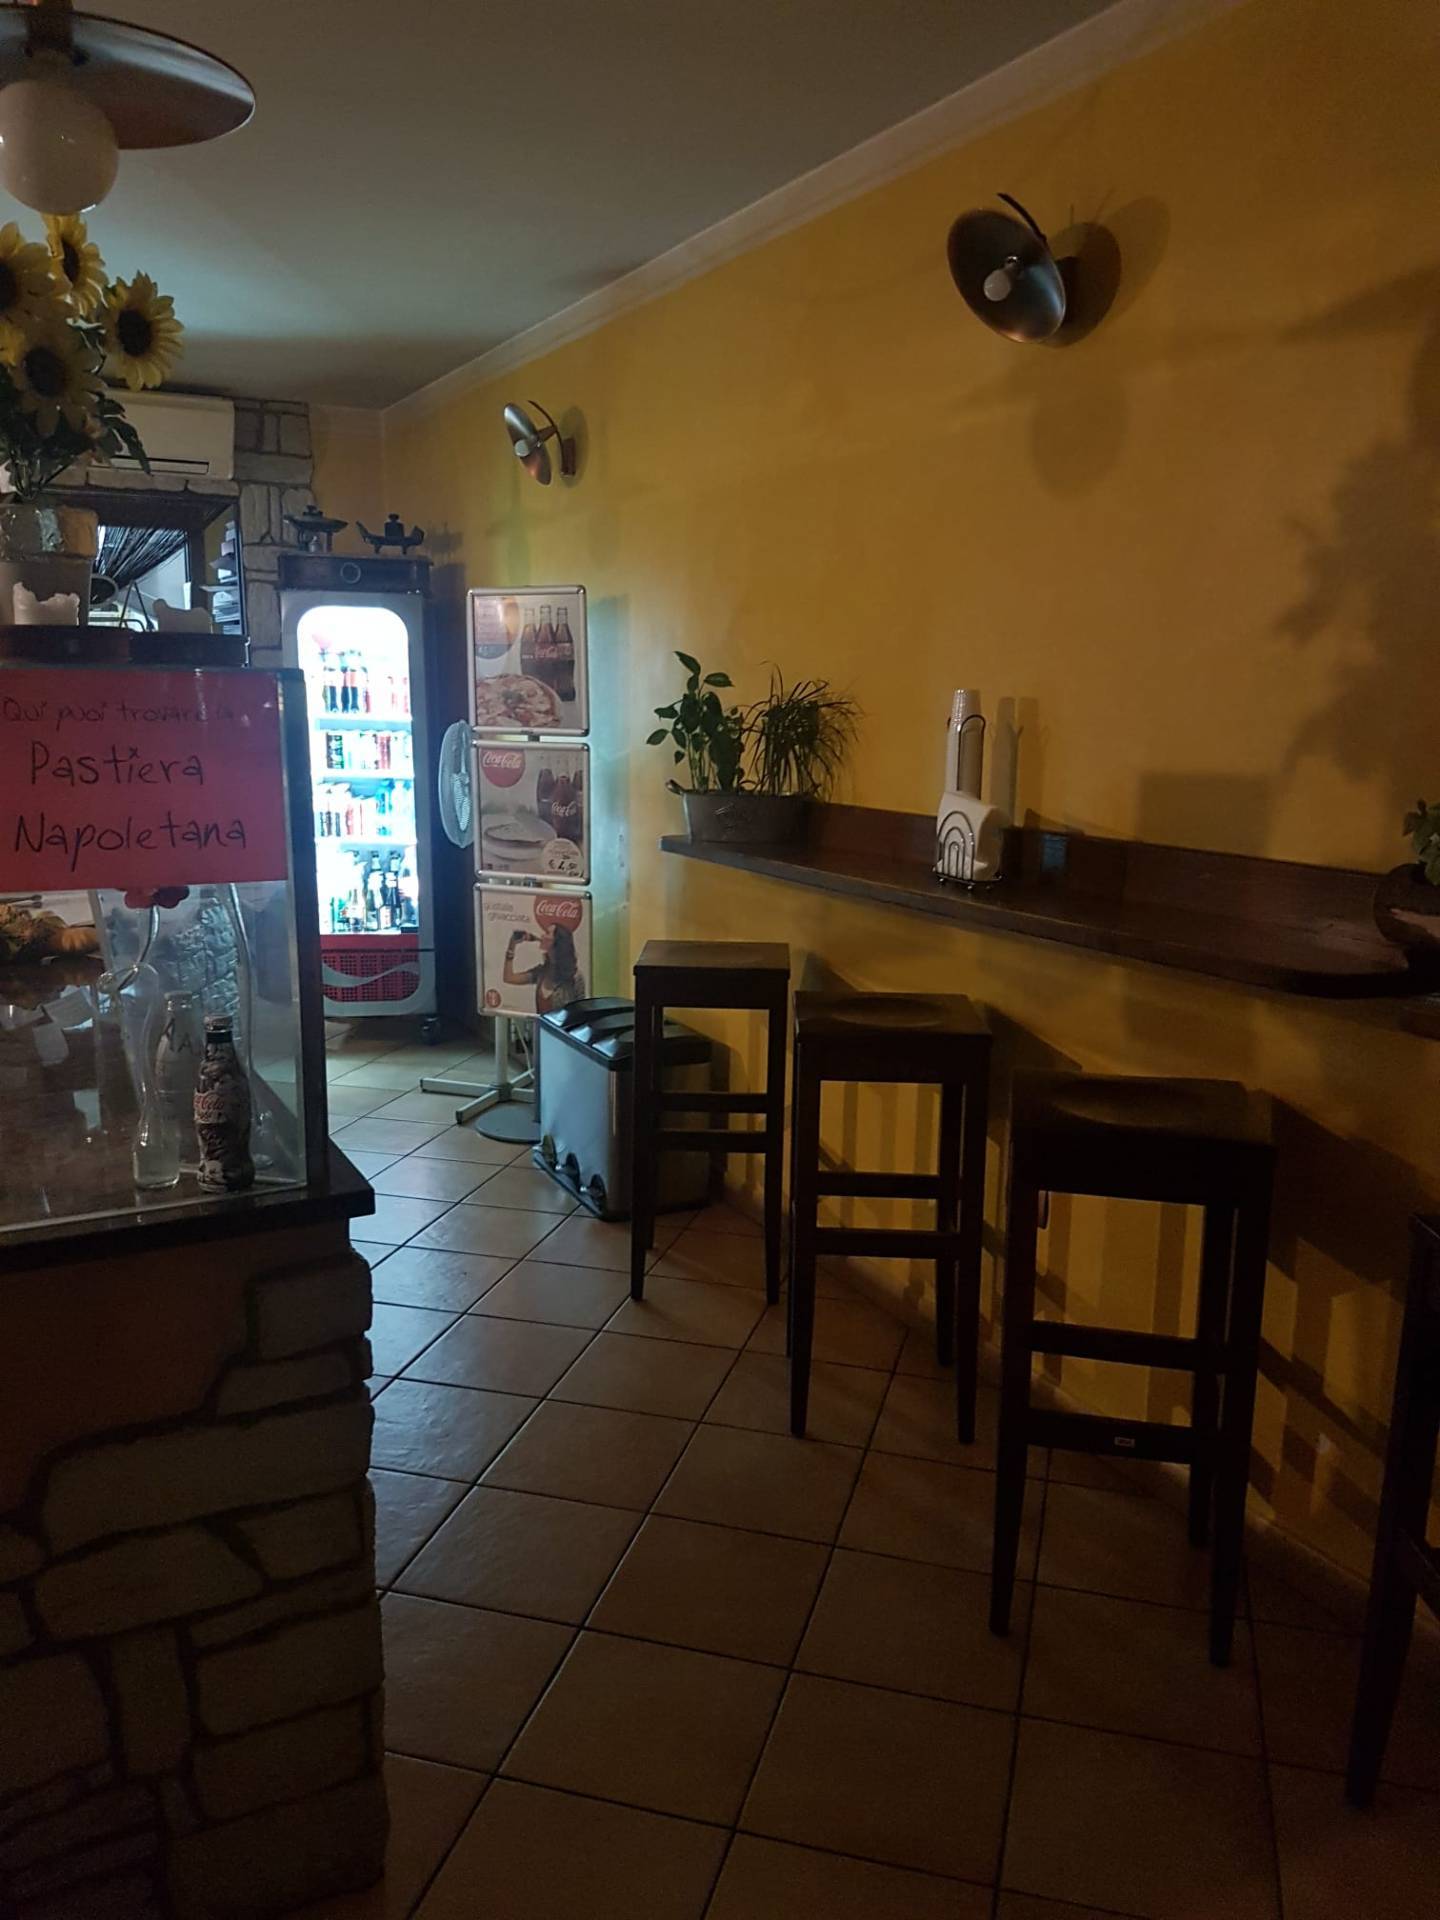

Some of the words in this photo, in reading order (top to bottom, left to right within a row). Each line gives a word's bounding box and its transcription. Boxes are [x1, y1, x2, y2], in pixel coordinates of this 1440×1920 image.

[2, 696, 47, 722] Qui
[30, 740, 205, 785] Pastiera
[15, 811, 248, 872] Napoletana
[536, 900, 579, 919] Coca-Cola
